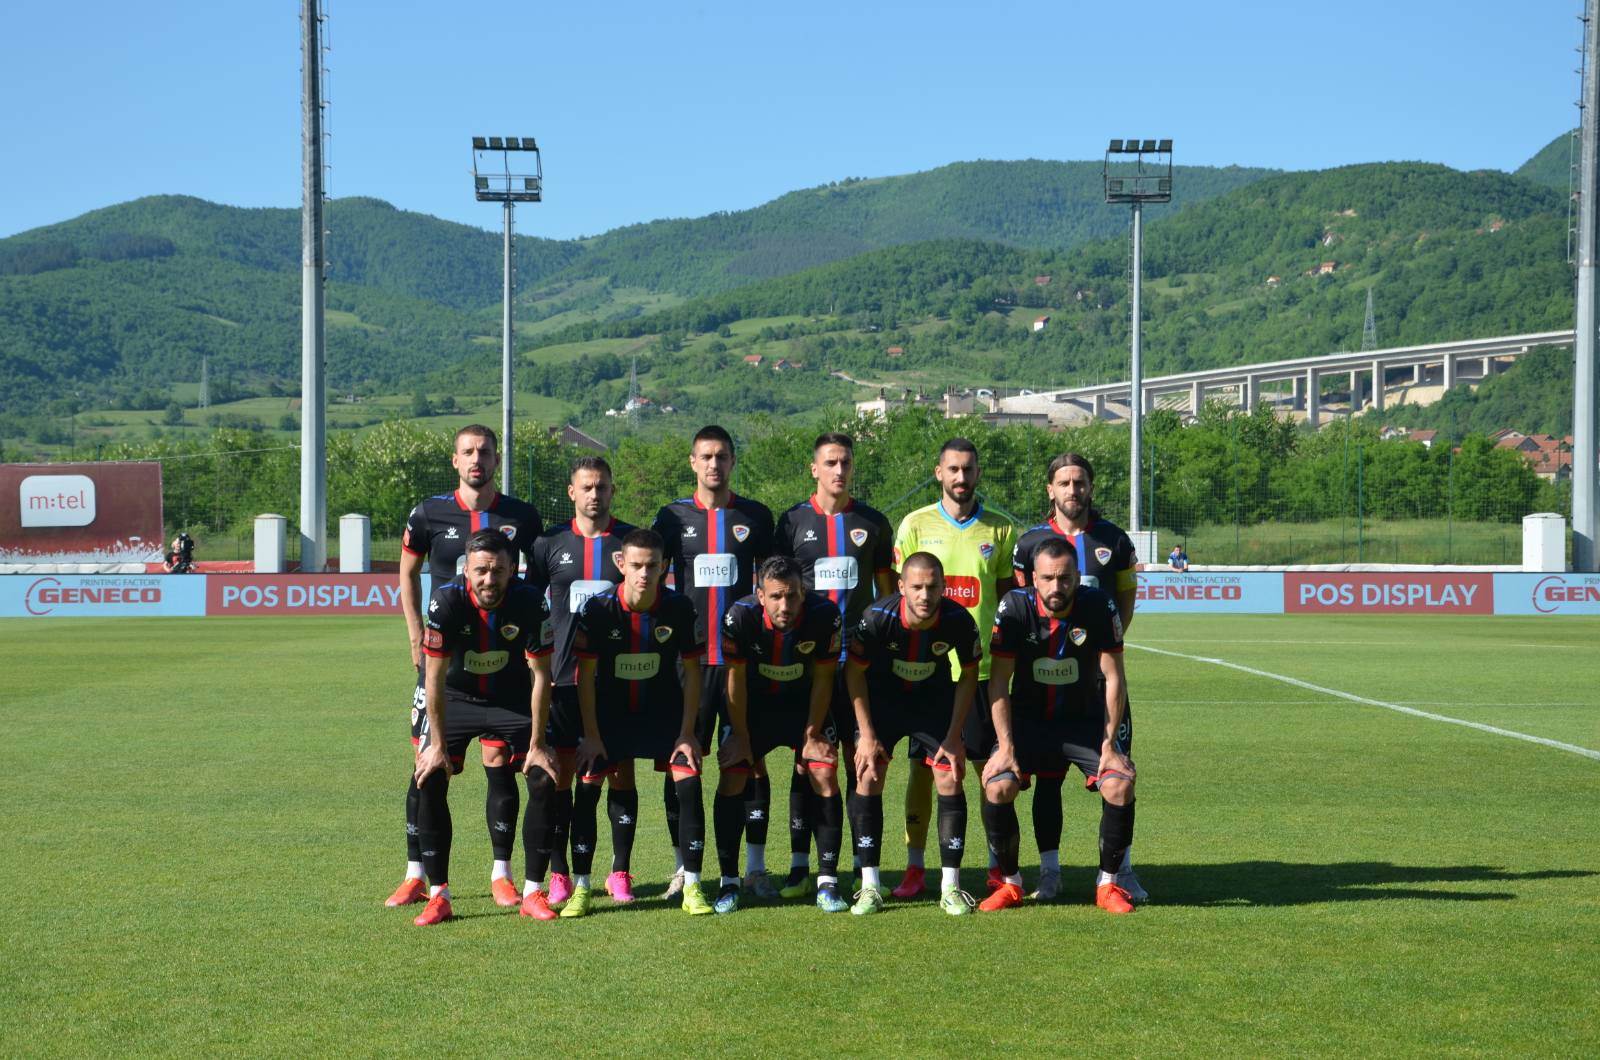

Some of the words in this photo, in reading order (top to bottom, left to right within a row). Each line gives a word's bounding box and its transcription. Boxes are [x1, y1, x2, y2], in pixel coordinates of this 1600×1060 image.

[30, 490, 86, 510] m:tel
[819, 566, 853, 579] m:tel
[80, 578, 121, 587] PRINTING
[123, 578, 161, 587] FACTORY
[1164, 576, 1203, 585] PRINTING
[1205, 576, 1242, 585] FACTORY
[38, 588, 162, 604] GENECO
[223, 585, 279, 608] POS
[287, 585, 401, 607] DISPLAY
[1299, 584, 1355, 606] POS
[1362, 584, 1478, 606] DISPLAY
[620, 659, 656, 672] m:tel
[1038, 664, 1073, 677] m:tel
[413, 685, 427, 710] 95
